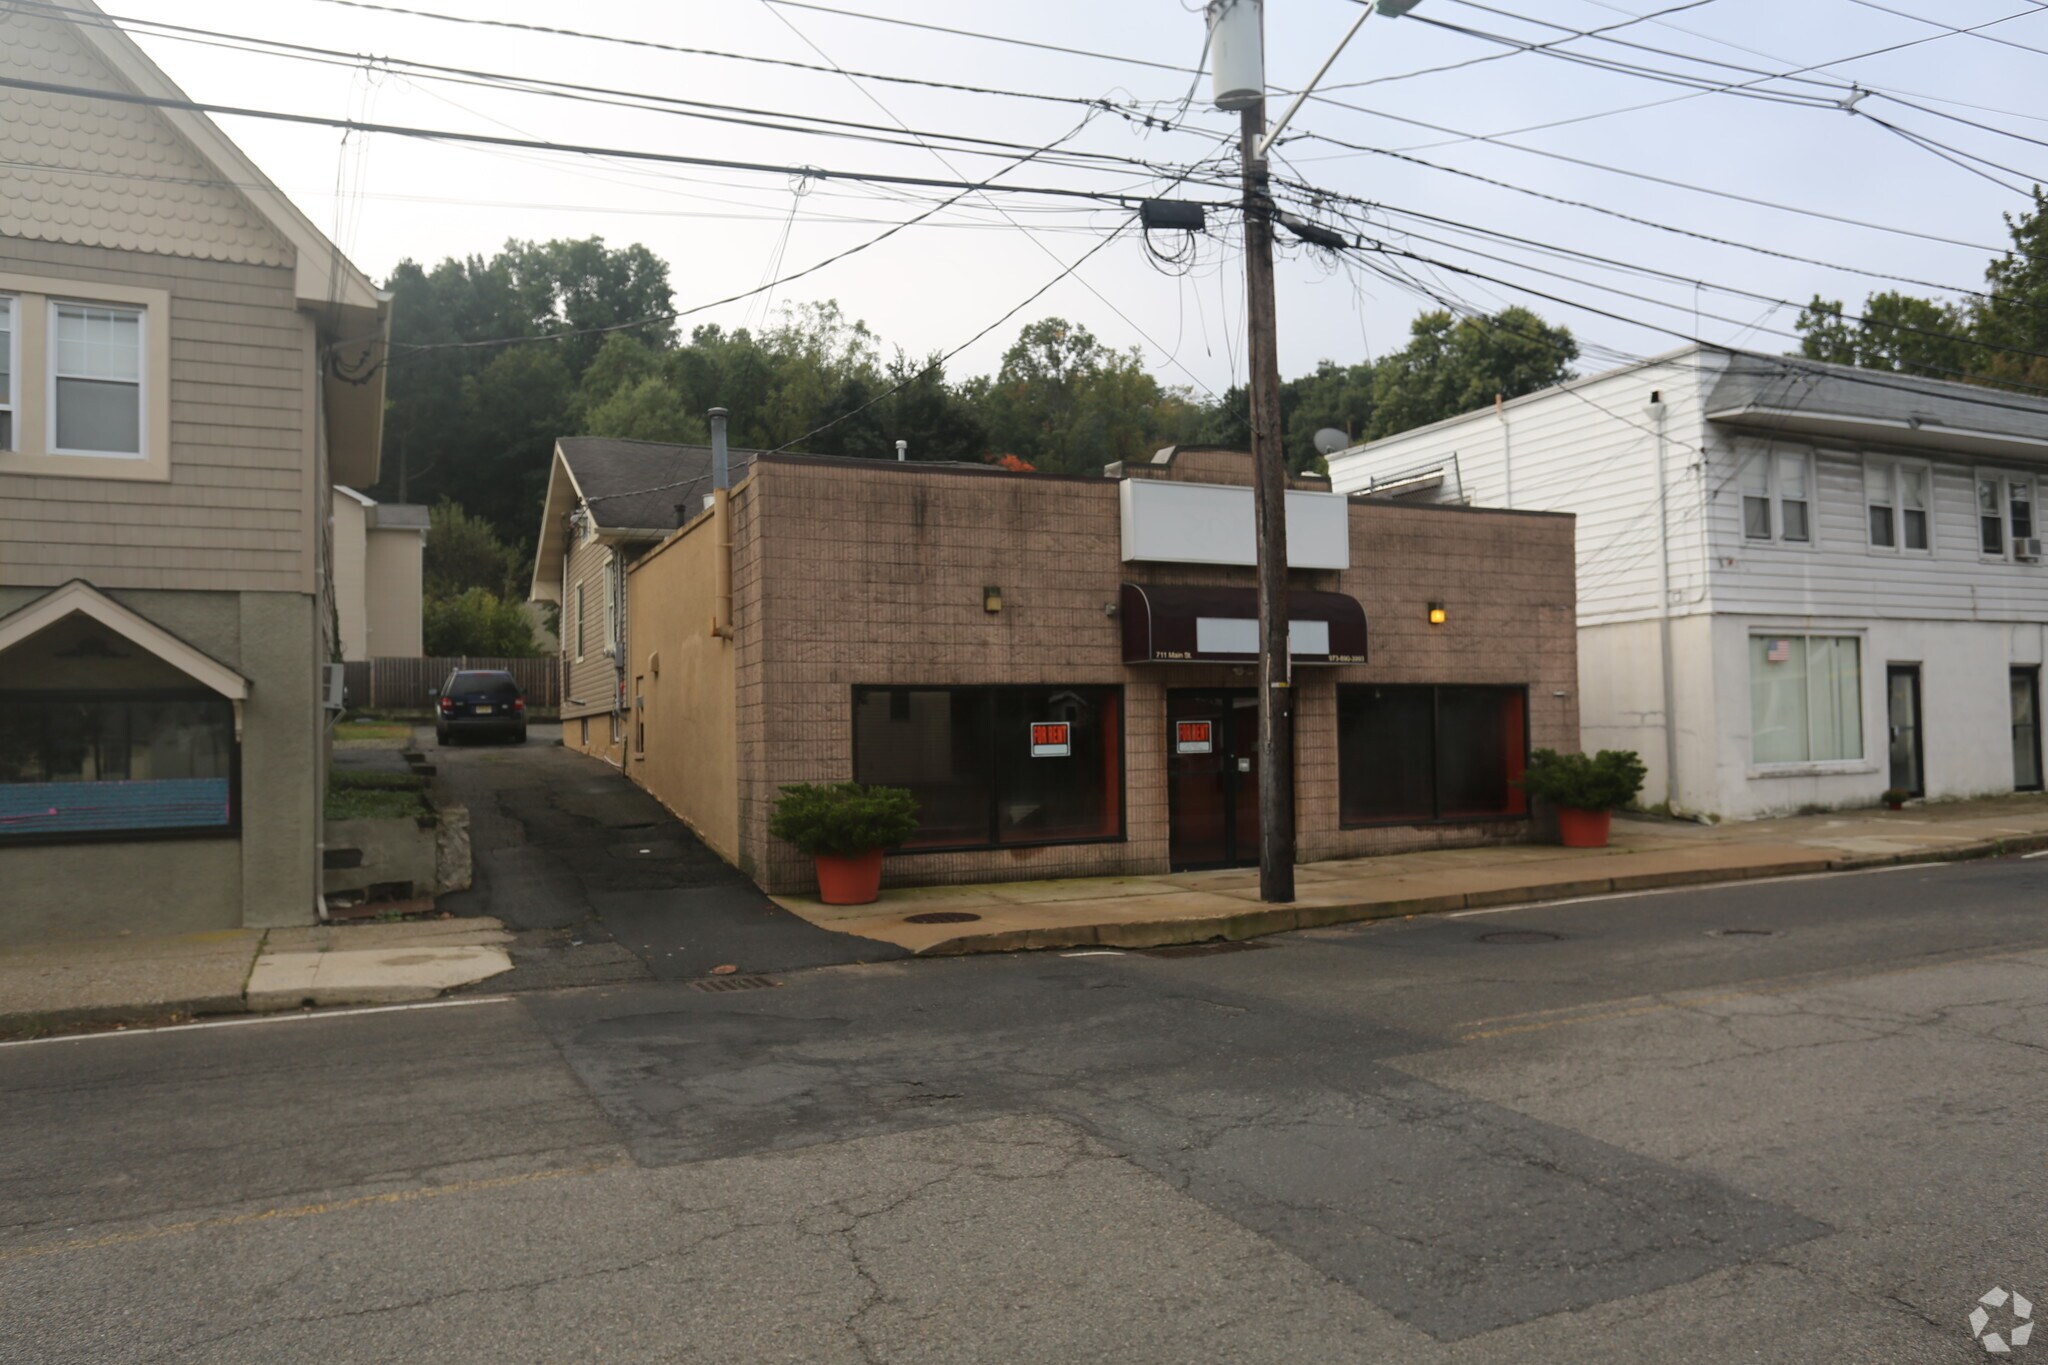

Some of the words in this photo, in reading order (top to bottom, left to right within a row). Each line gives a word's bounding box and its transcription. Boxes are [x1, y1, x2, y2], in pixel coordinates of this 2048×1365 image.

[1156, 651, 1167, 659] 711
[1168, 651, 1184, 659] Main
[1033, 725, 1047, 744] FOR
[1048, 725, 1067, 743] RENT
[1179, 723, 1191, 741] FOR
[1192, 723, 1209, 741] RENT
